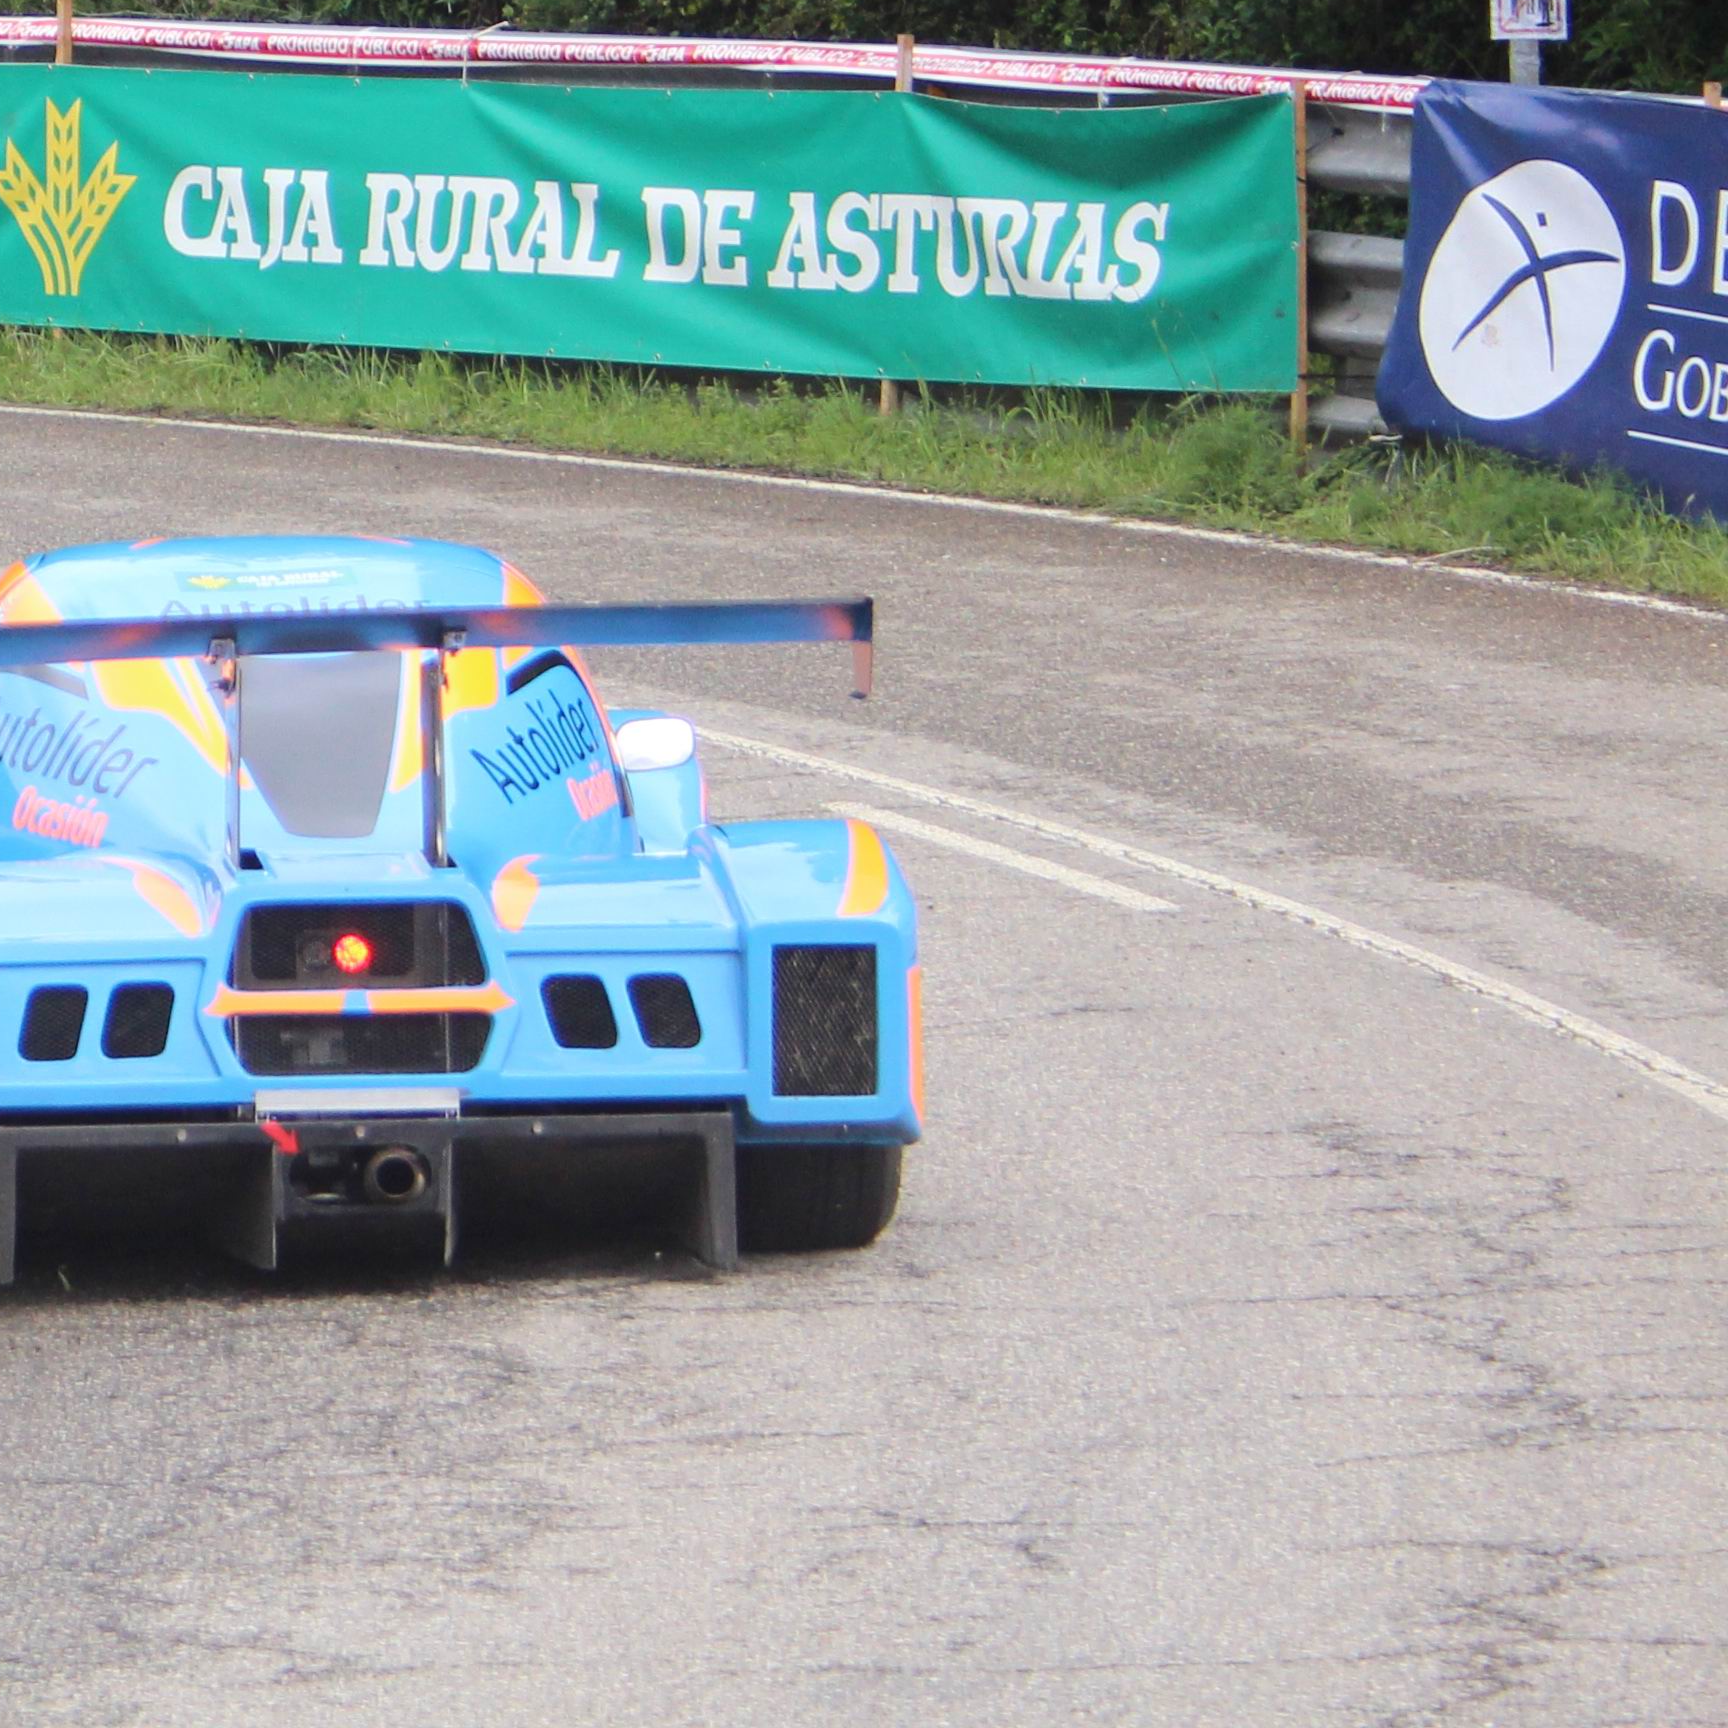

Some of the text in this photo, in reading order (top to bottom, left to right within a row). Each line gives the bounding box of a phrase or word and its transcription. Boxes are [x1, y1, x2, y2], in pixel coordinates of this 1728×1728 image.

[163, 165, 1170, 304] CAJA RURAL DE ASTURIAS
[469, 688, 600, 805] Autolíder
[11, 785, 110, 849] Ocasión
